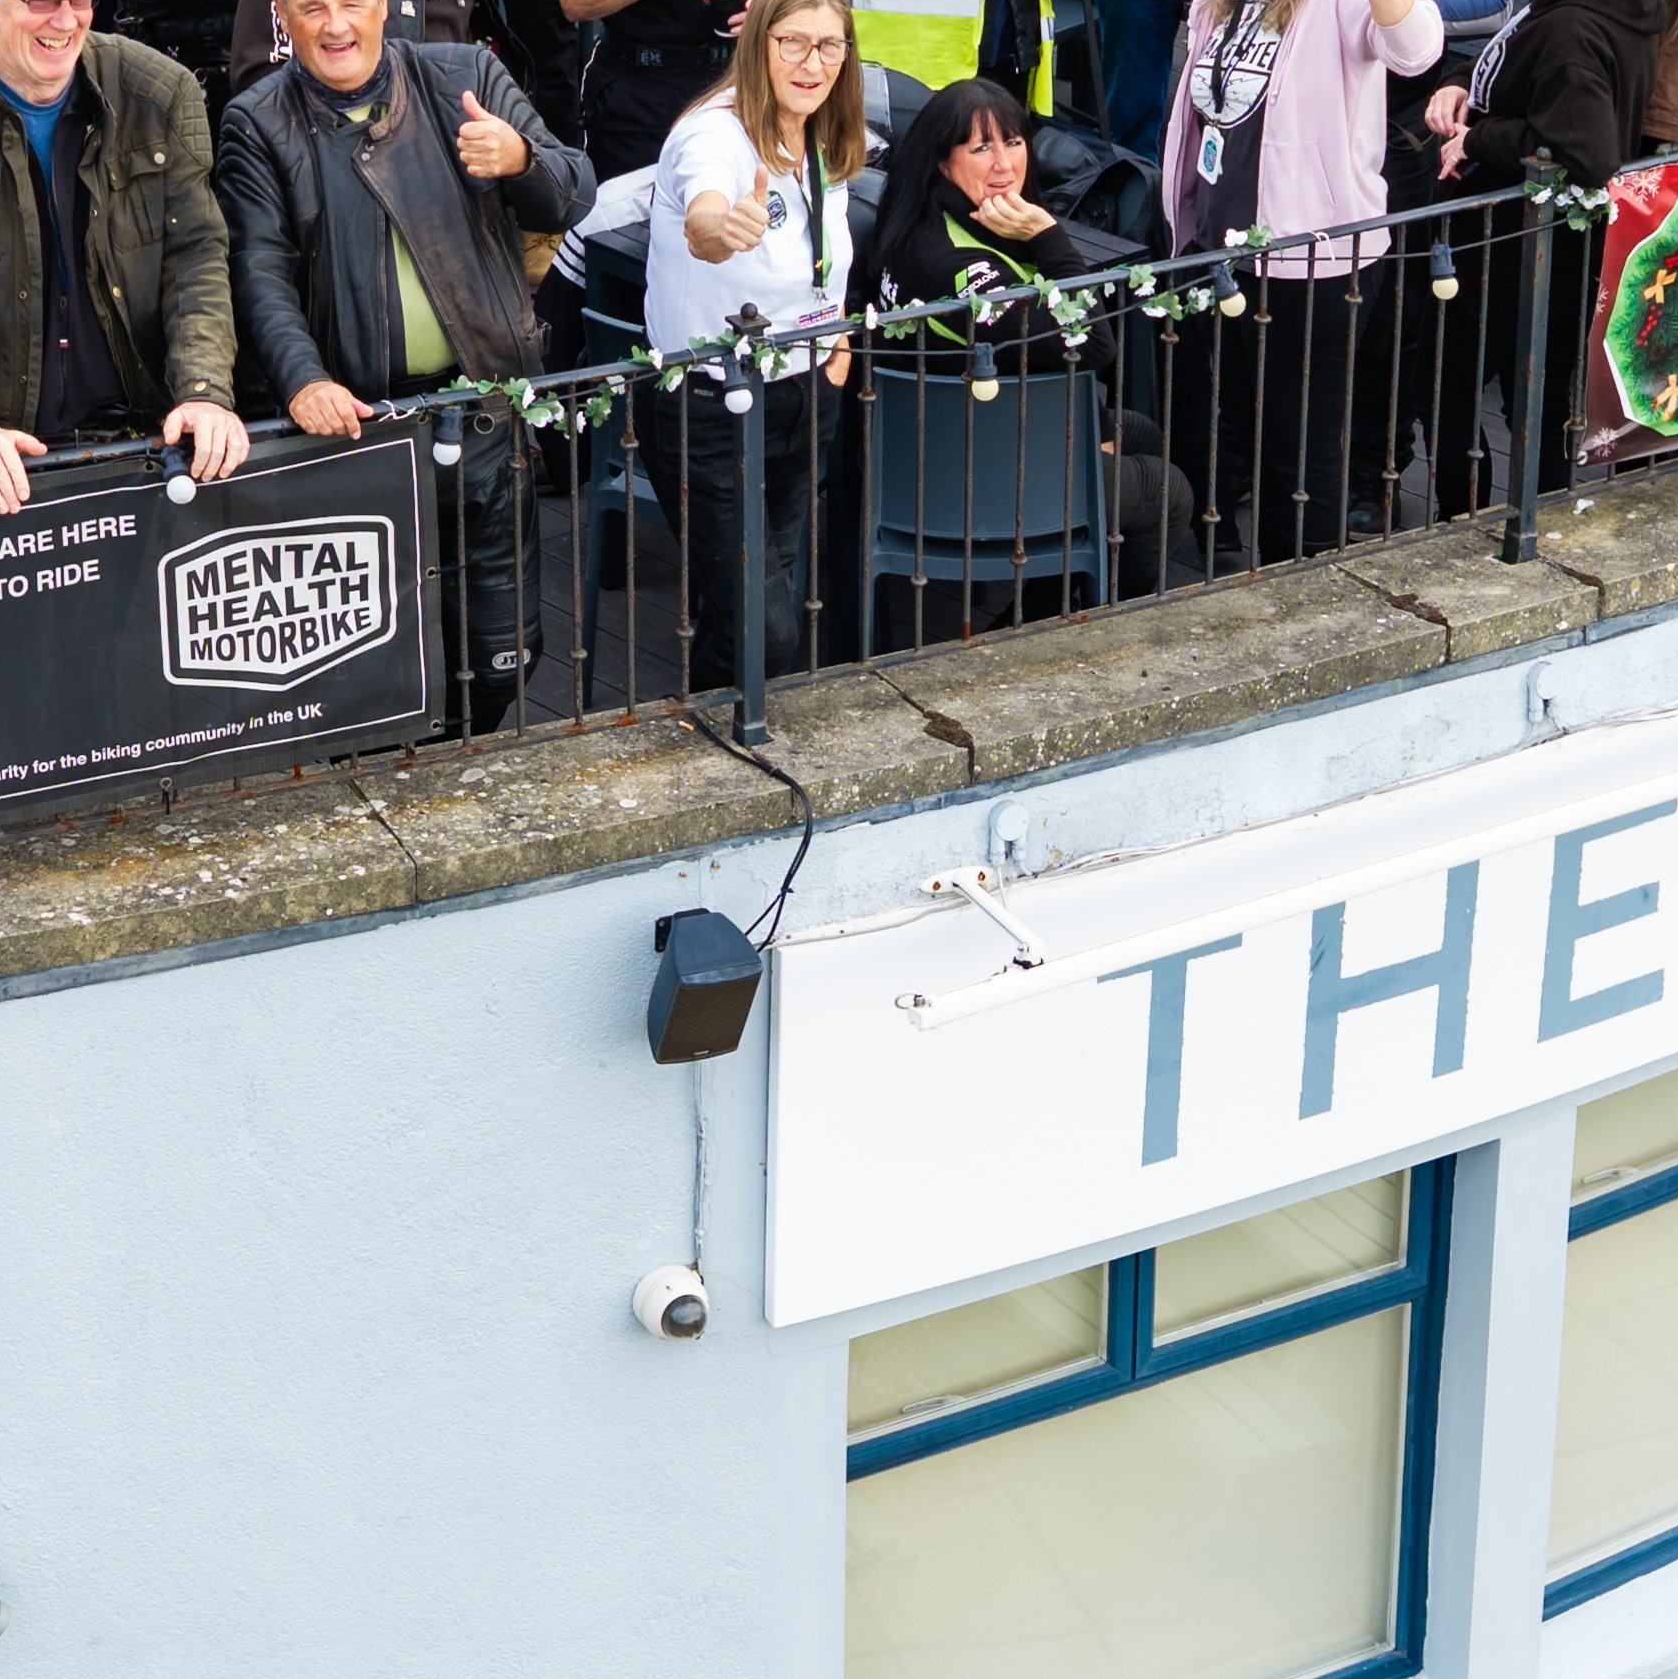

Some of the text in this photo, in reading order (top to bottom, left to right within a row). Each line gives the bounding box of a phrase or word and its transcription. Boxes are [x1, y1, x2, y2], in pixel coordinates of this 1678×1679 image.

[957, 270, 1000, 299] RIDOLOGY
[61, 514, 137, 547] HERE
[36, 559, 101, 592] RIDE
[186, 541, 369, 601] MENTAL
[188, 573, 369, 635] HEALTH
[190, 607, 372, 664] MOTORBIKE
[32, 757, 56, 775] for
[60, 752, 87, 770] the
[91, 742, 141, 765] biking
[145, 719, 245, 752] coummunity
[249, 714, 263, 730] in
[267, 708, 293, 725] the
[297, 702, 322, 720] UK
